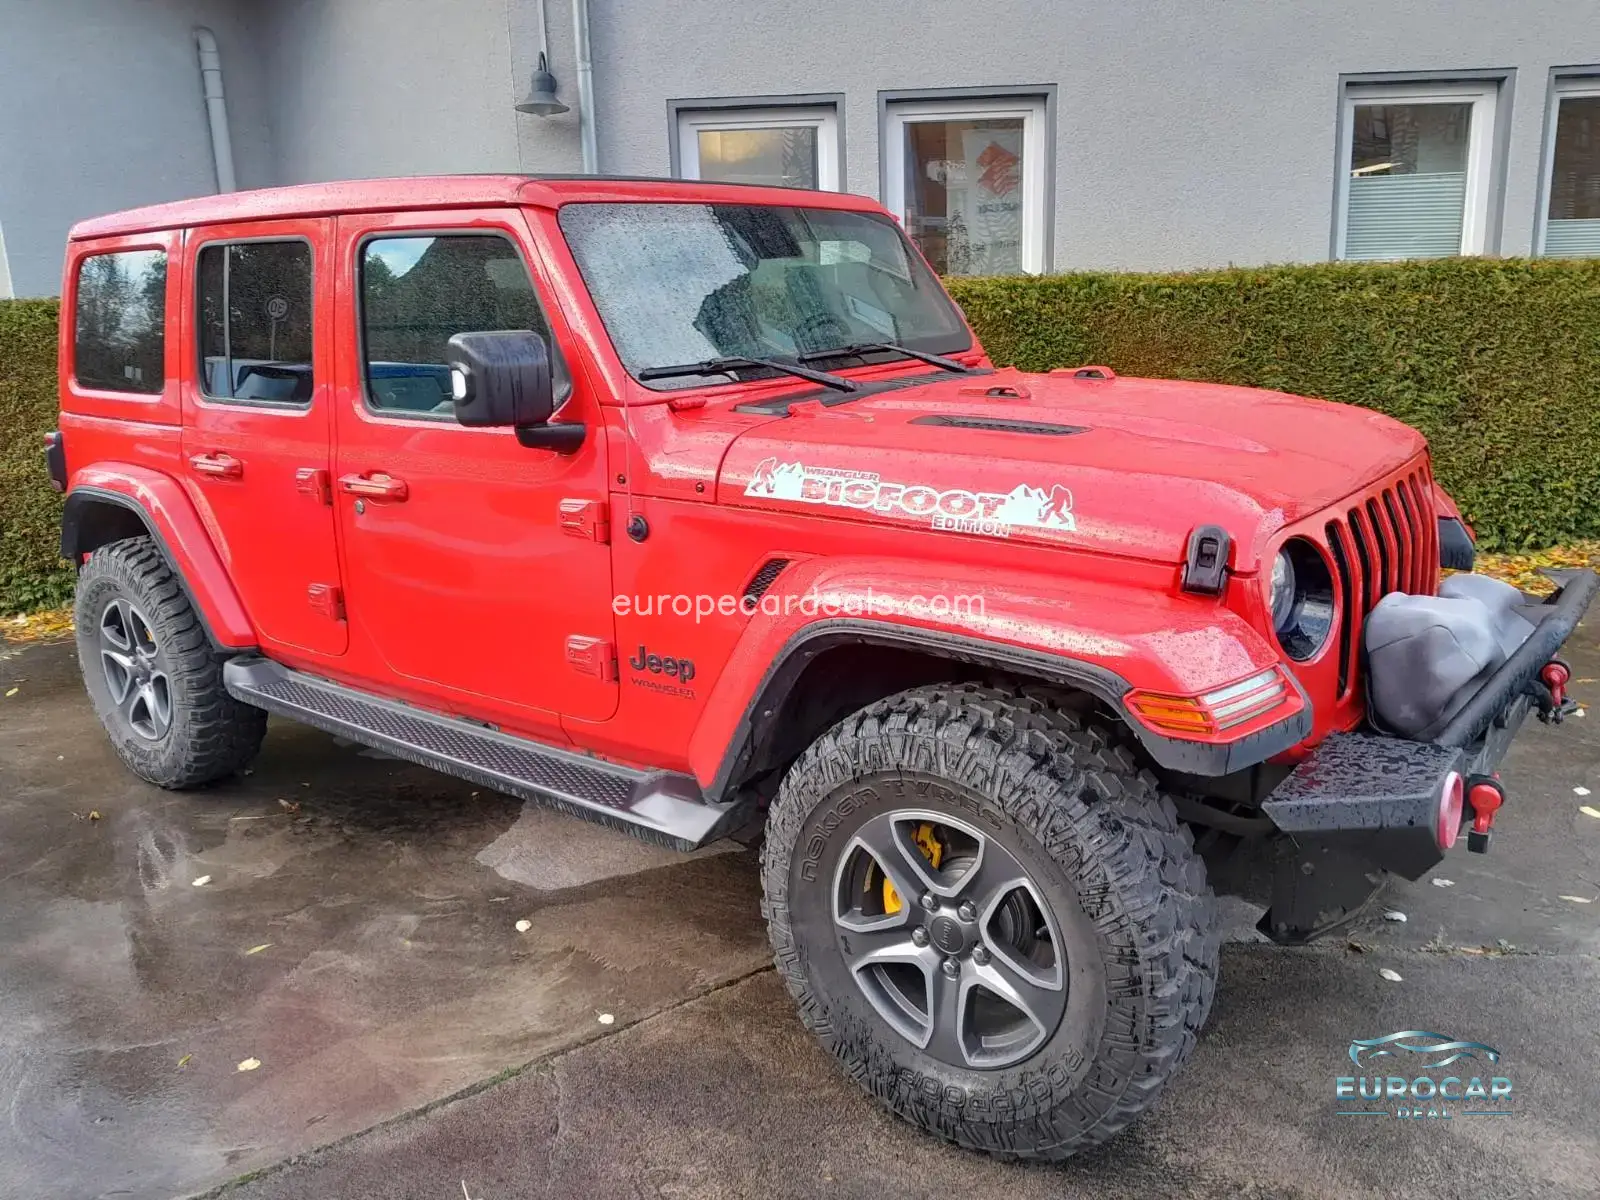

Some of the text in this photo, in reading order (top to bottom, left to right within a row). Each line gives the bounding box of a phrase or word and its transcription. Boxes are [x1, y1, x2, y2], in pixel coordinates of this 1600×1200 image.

[806, 467, 878, 481] WRANGLER
[801, 477, 1007, 517] BIGFOOT
[933, 516, 1009, 537] EDITION
[629, 645, 695, 684] Jeep
